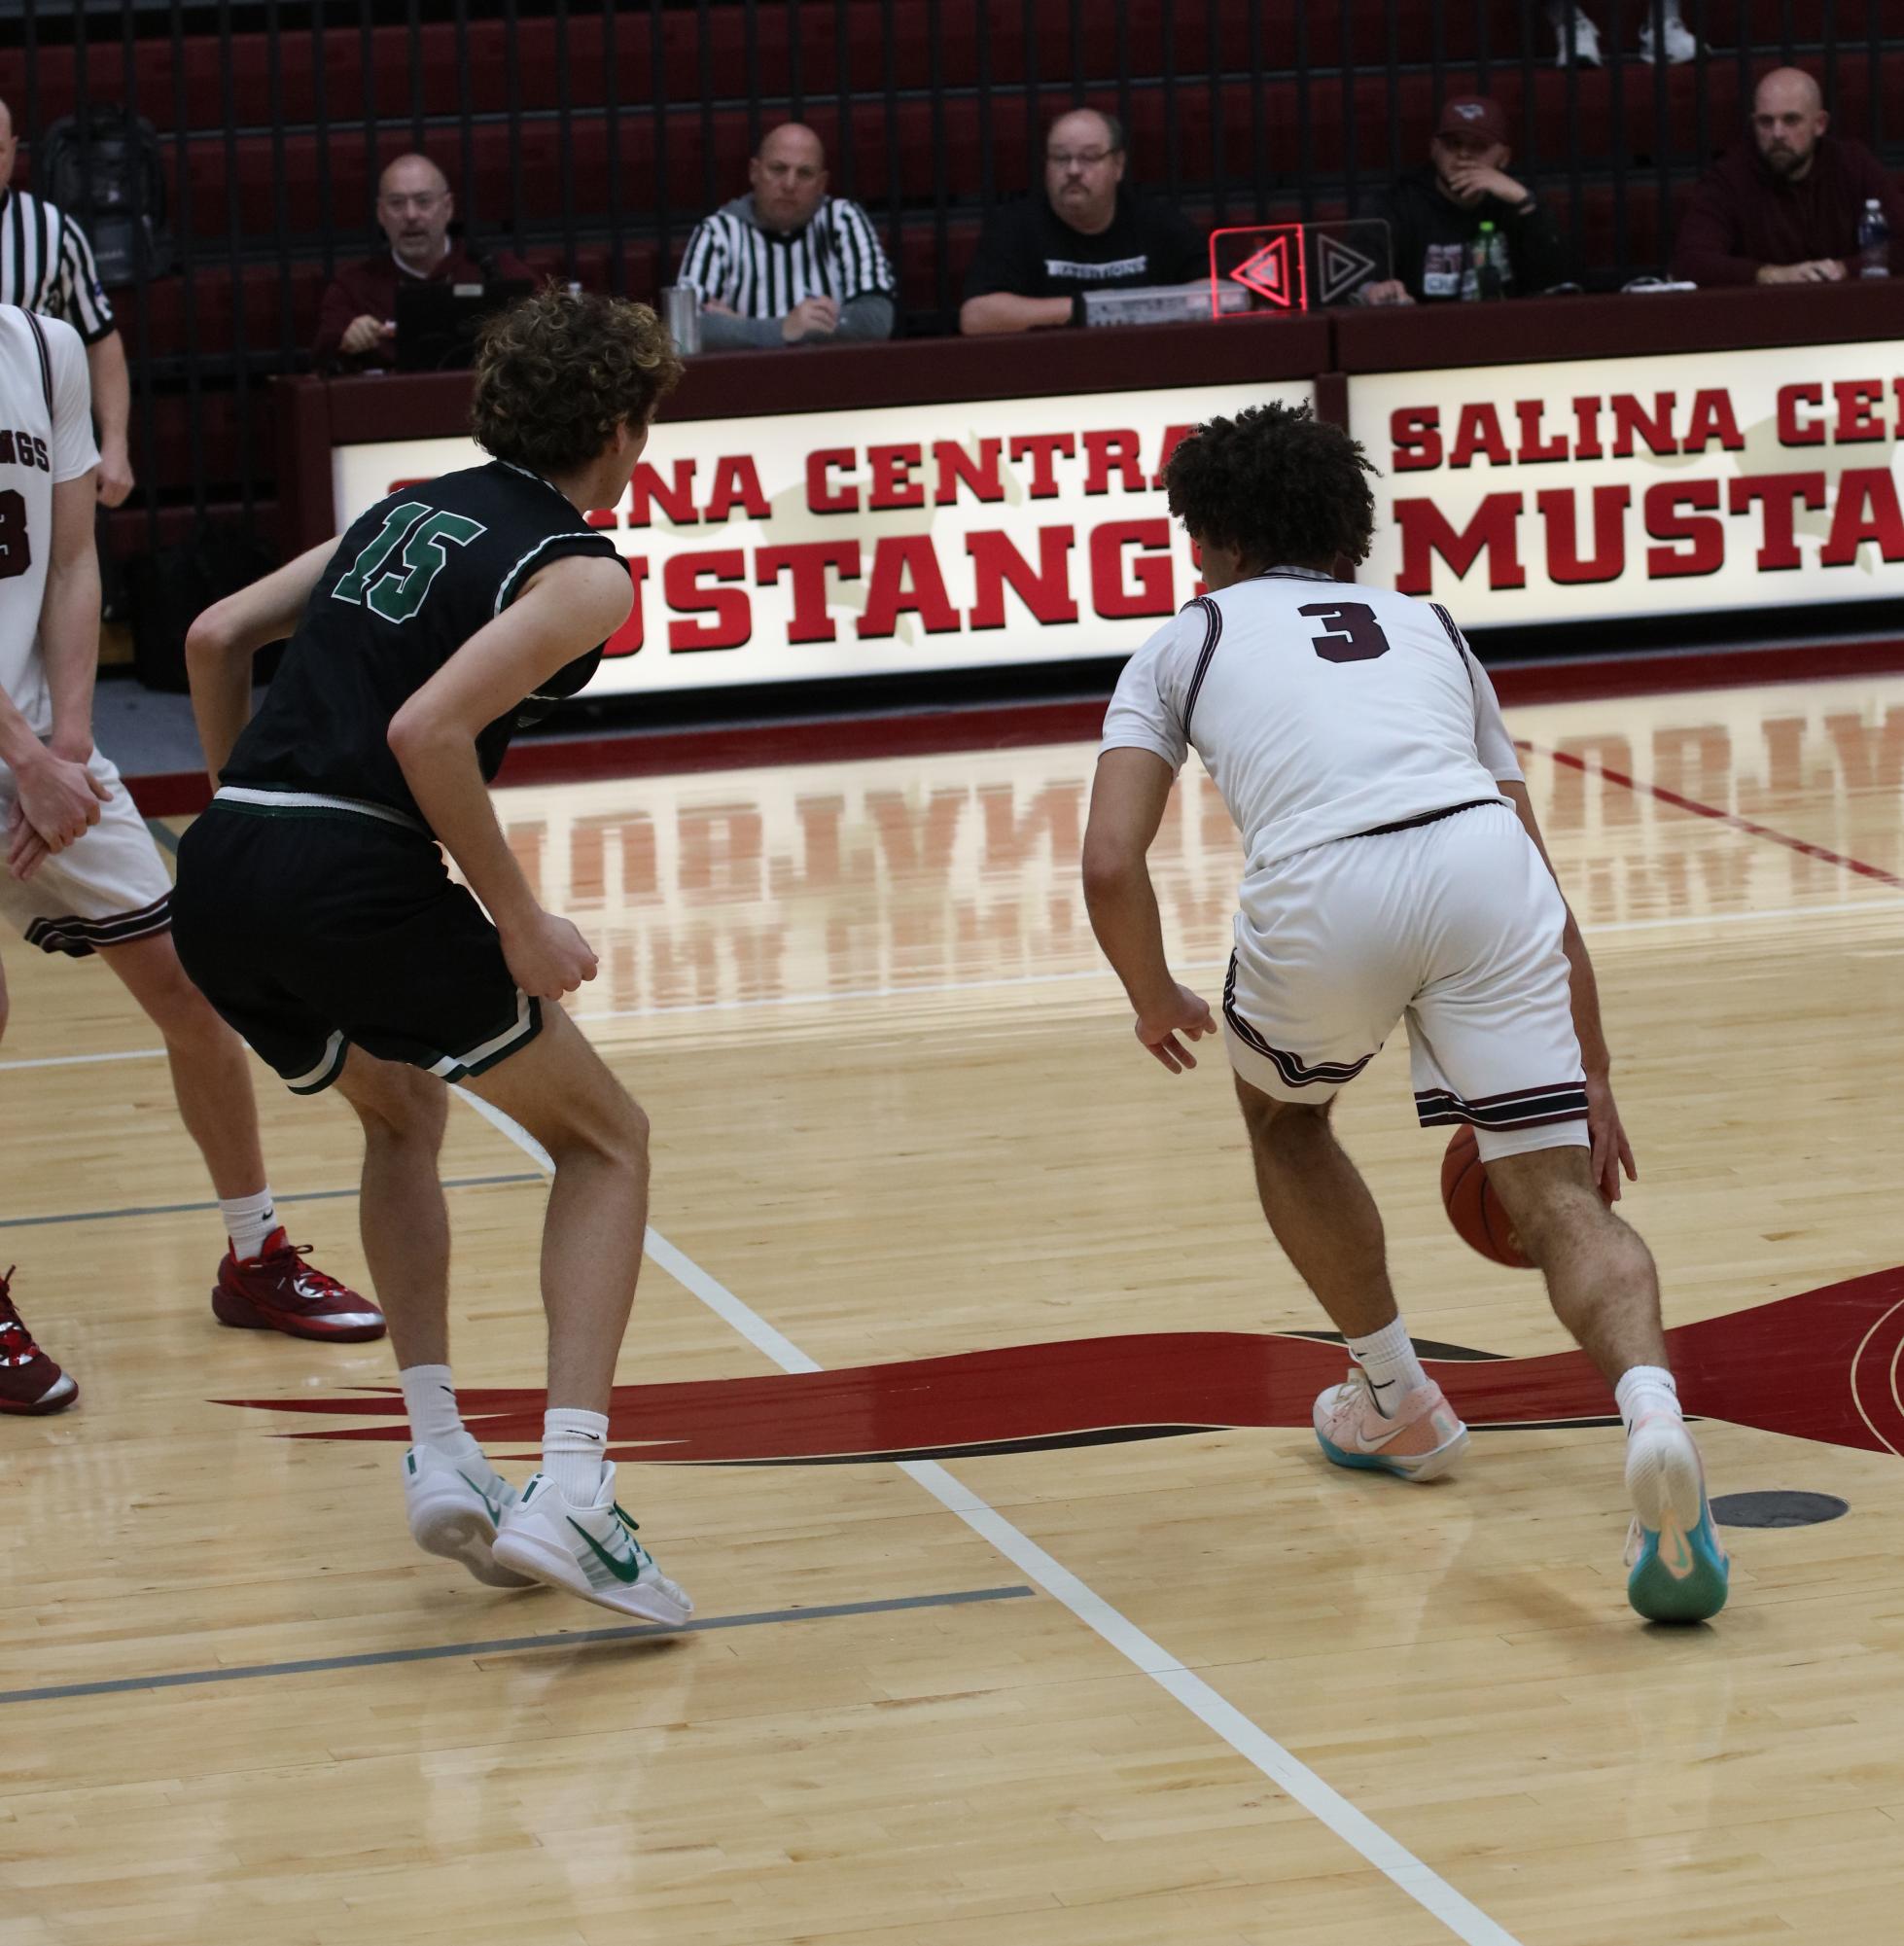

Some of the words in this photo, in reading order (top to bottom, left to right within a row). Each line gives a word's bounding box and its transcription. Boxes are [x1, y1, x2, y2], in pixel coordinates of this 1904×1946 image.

[1390, 388, 1745, 473] SALINA
[1777, 376, 1904, 447] CE
[332, 501, 487, 623] 15
[1297, 601, 1391, 663] 3
